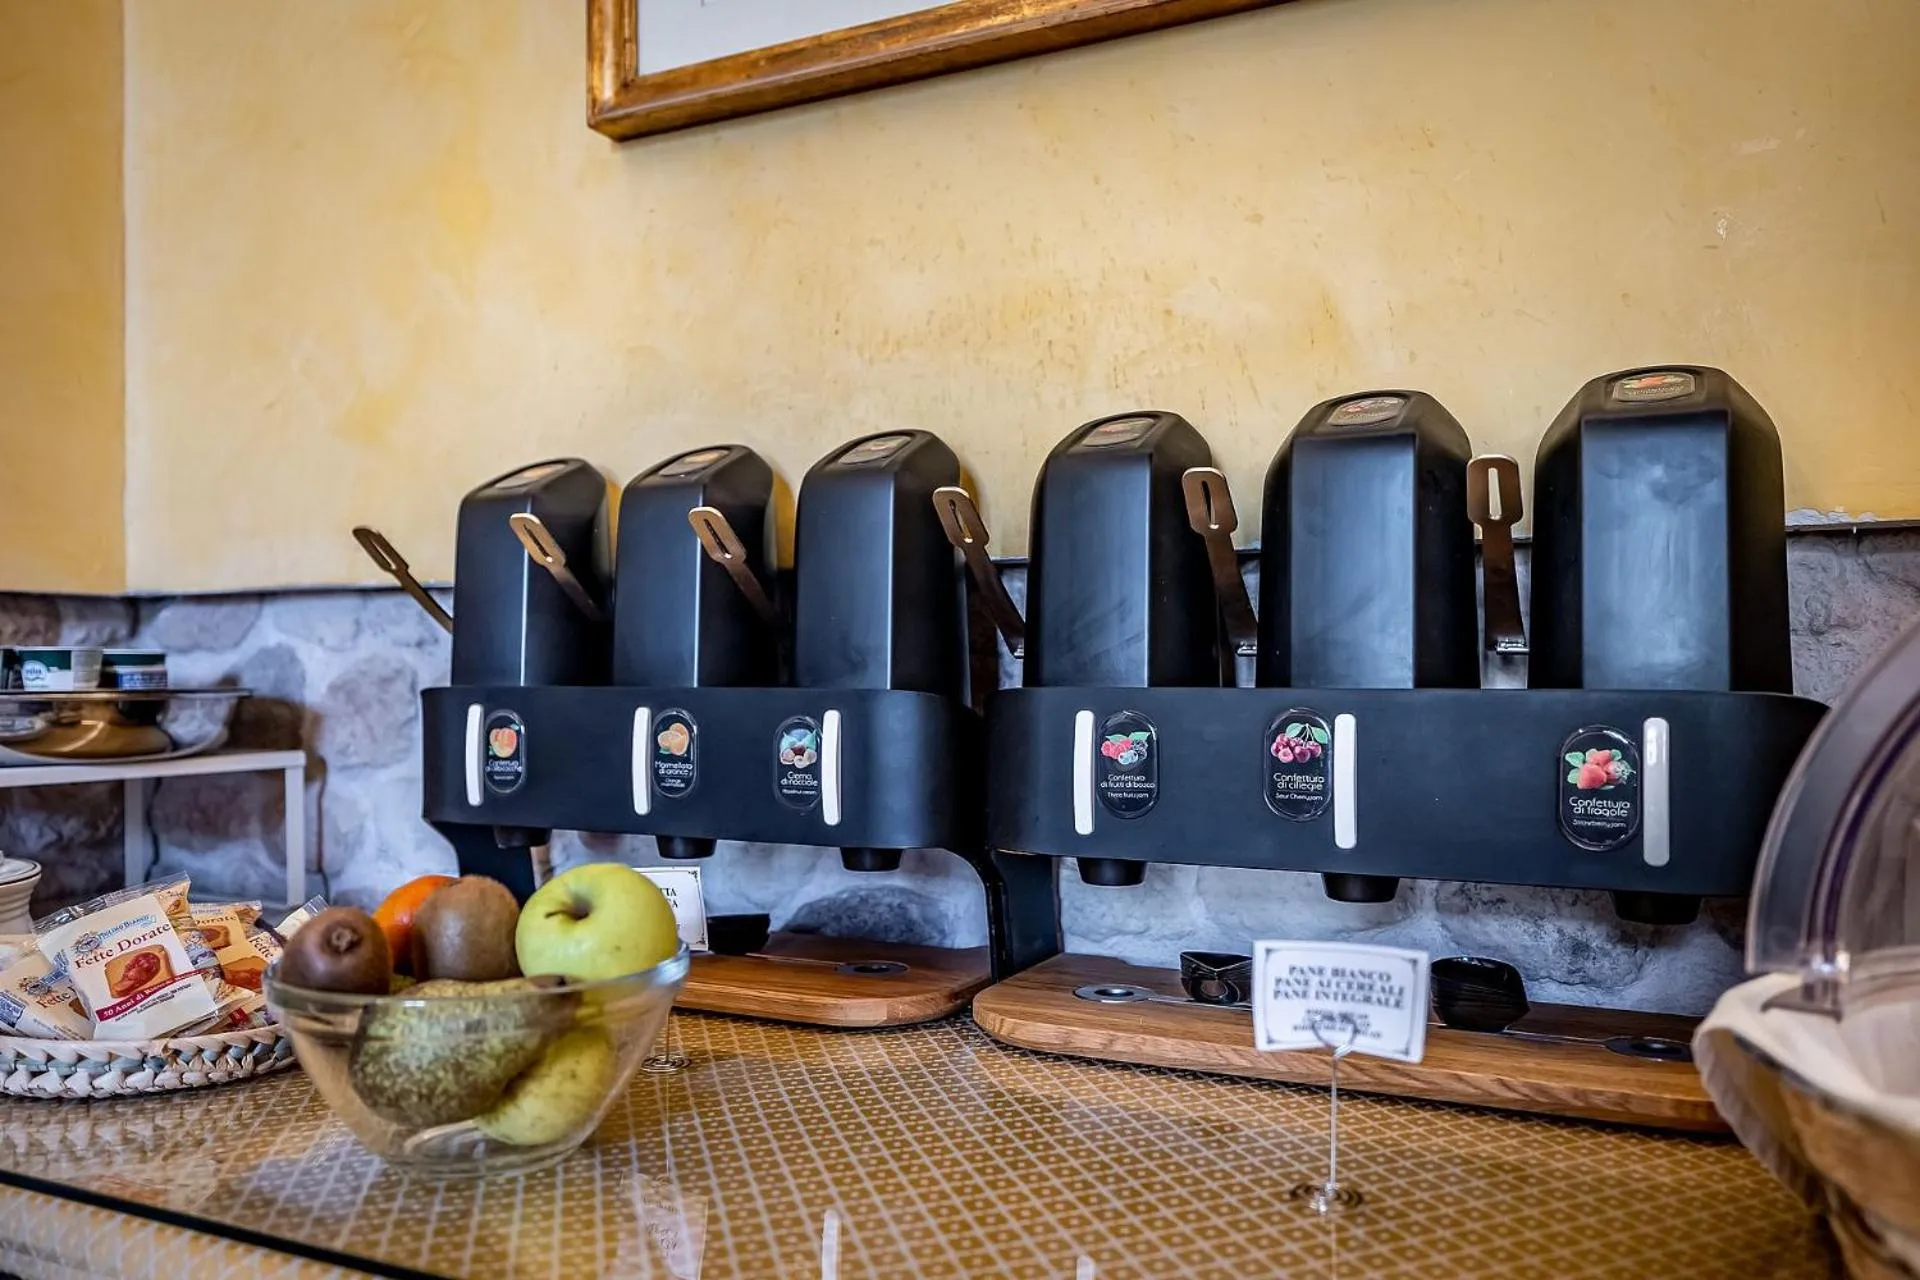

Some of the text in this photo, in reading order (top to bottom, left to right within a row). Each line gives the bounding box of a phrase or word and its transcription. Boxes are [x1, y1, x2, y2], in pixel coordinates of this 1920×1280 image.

[1272, 772, 1325, 783] Confettura
[1569, 796, 1630, 808] Confettura
[1574, 805, 1628, 817] di fragole
[74, 921, 171, 970] Fette Dorate
[1288, 965, 1392, 983] PANE BIANCO
[1274, 976, 1310, 988] PANE
[1273, 989, 1404, 1010] PANE INTEGRALE
